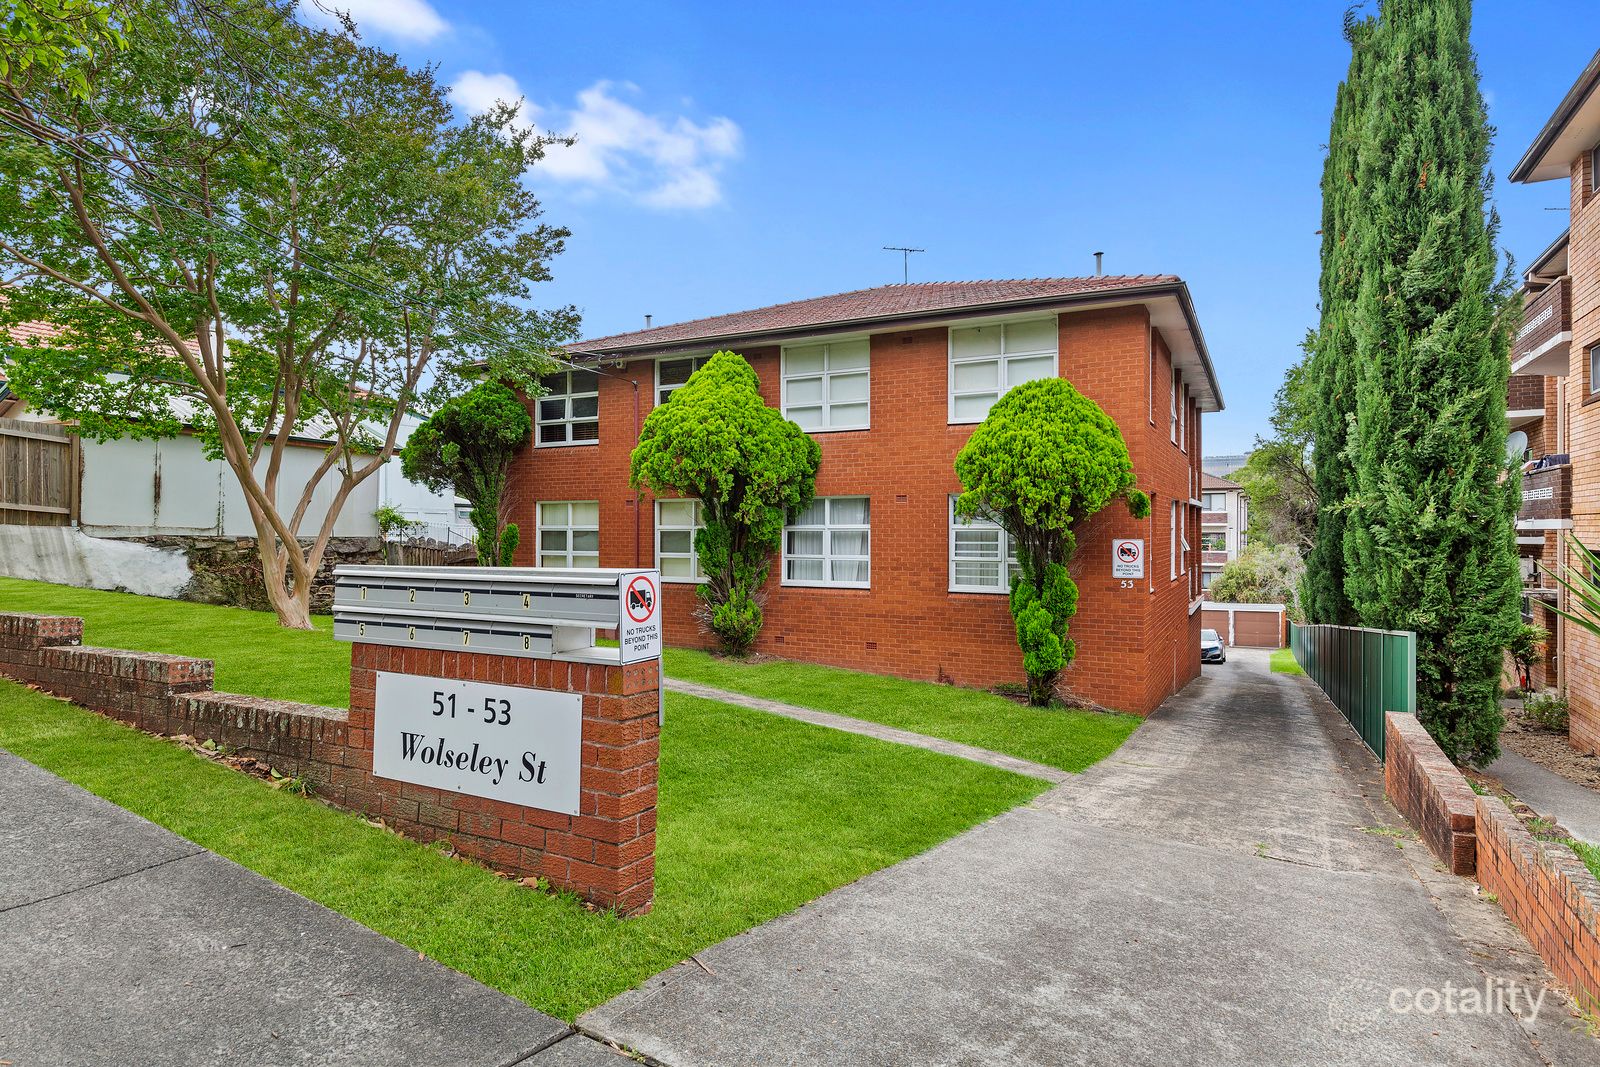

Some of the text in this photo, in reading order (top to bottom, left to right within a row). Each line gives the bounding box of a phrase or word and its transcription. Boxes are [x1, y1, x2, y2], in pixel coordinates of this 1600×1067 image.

[1120, 580, 1134, 588] 53
[362, 588, 529, 608] 1 2 3 4
[360, 624, 529, 649] 5 6 7 8
[636, 625, 656, 634] TRUCKS
[625, 633, 658, 645] BEYOND THIS
[634, 643, 650, 651] POINT
[432, 691, 456, 718] 51
[484, 697, 511, 725] 53
[400, 732, 547, 785] Wolseley St
